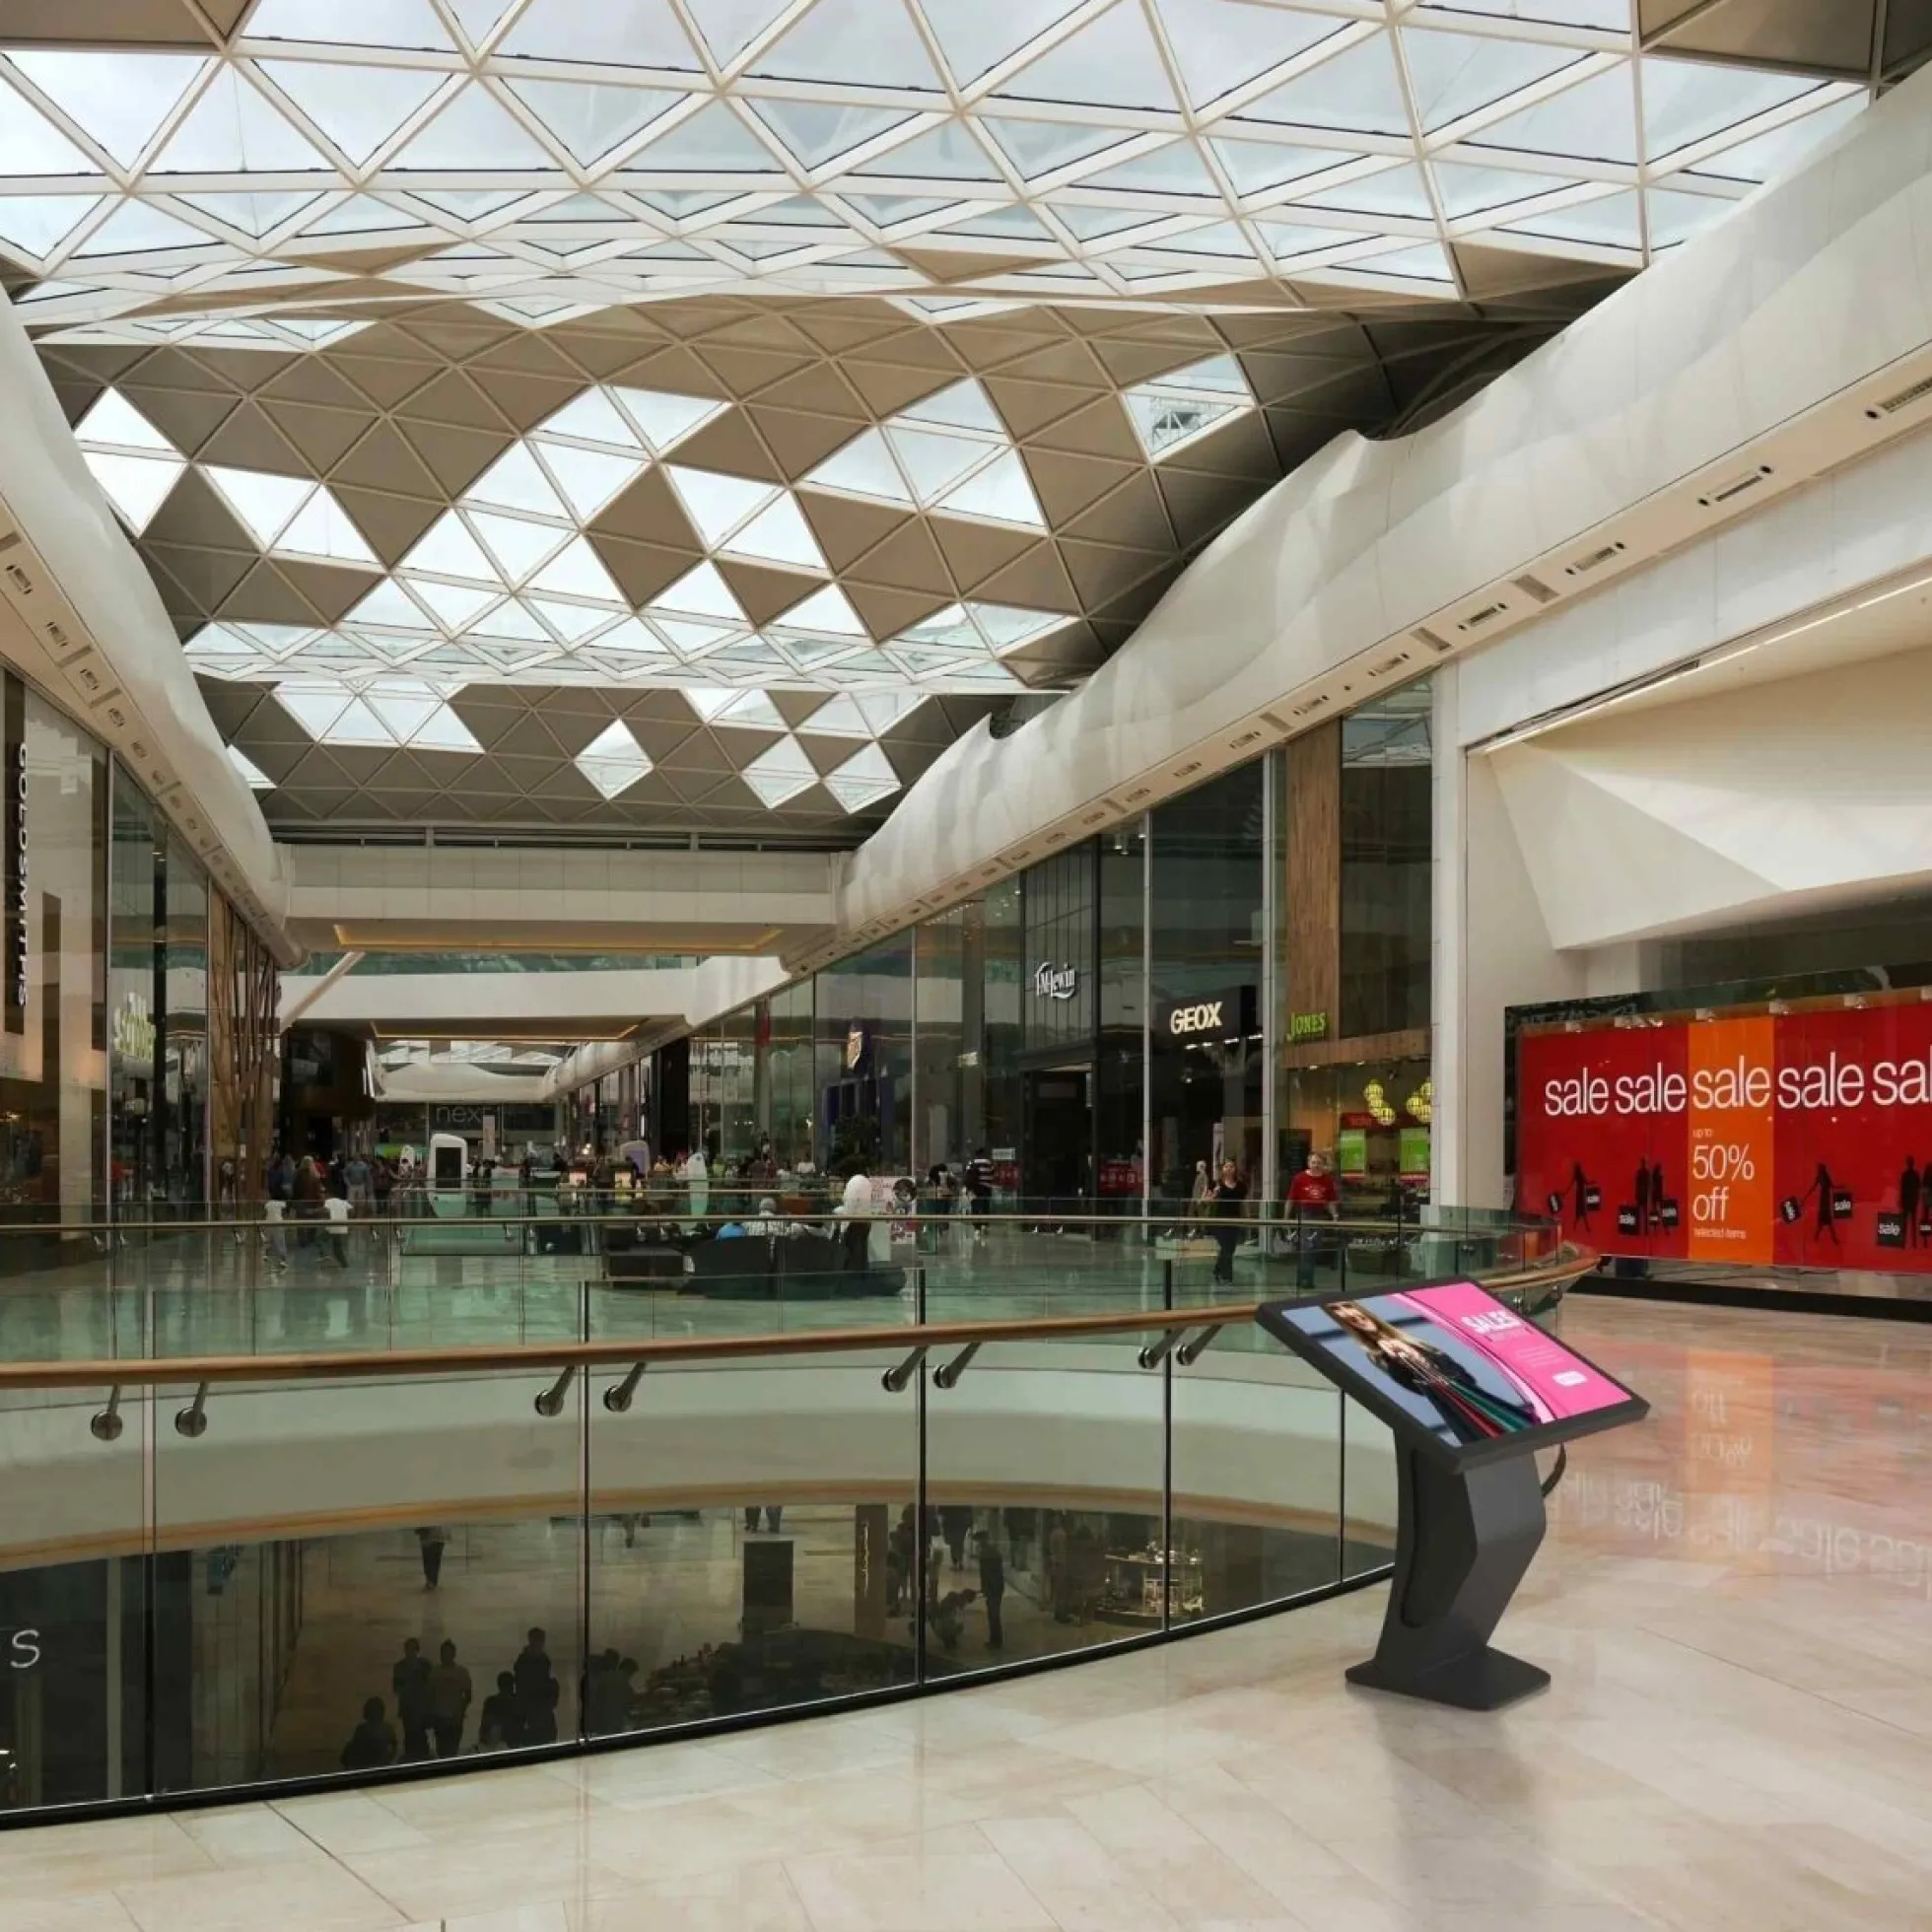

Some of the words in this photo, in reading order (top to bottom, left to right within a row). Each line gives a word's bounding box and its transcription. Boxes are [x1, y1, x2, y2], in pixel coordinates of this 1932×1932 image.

[1170, 1001, 1223, 1035] GEOX
[1286, 1012, 1326, 1042] JONES
[1545, 1067, 1609, 1116] sale
[1615, 1062, 1687, 1113] sale
[1691, 1055, 1771, 1110] sale
[1777, 1051, 1865, 1109] sale
[1692, 1143, 1755, 1181] 50%
[1692, 1186, 1730, 1221] off
